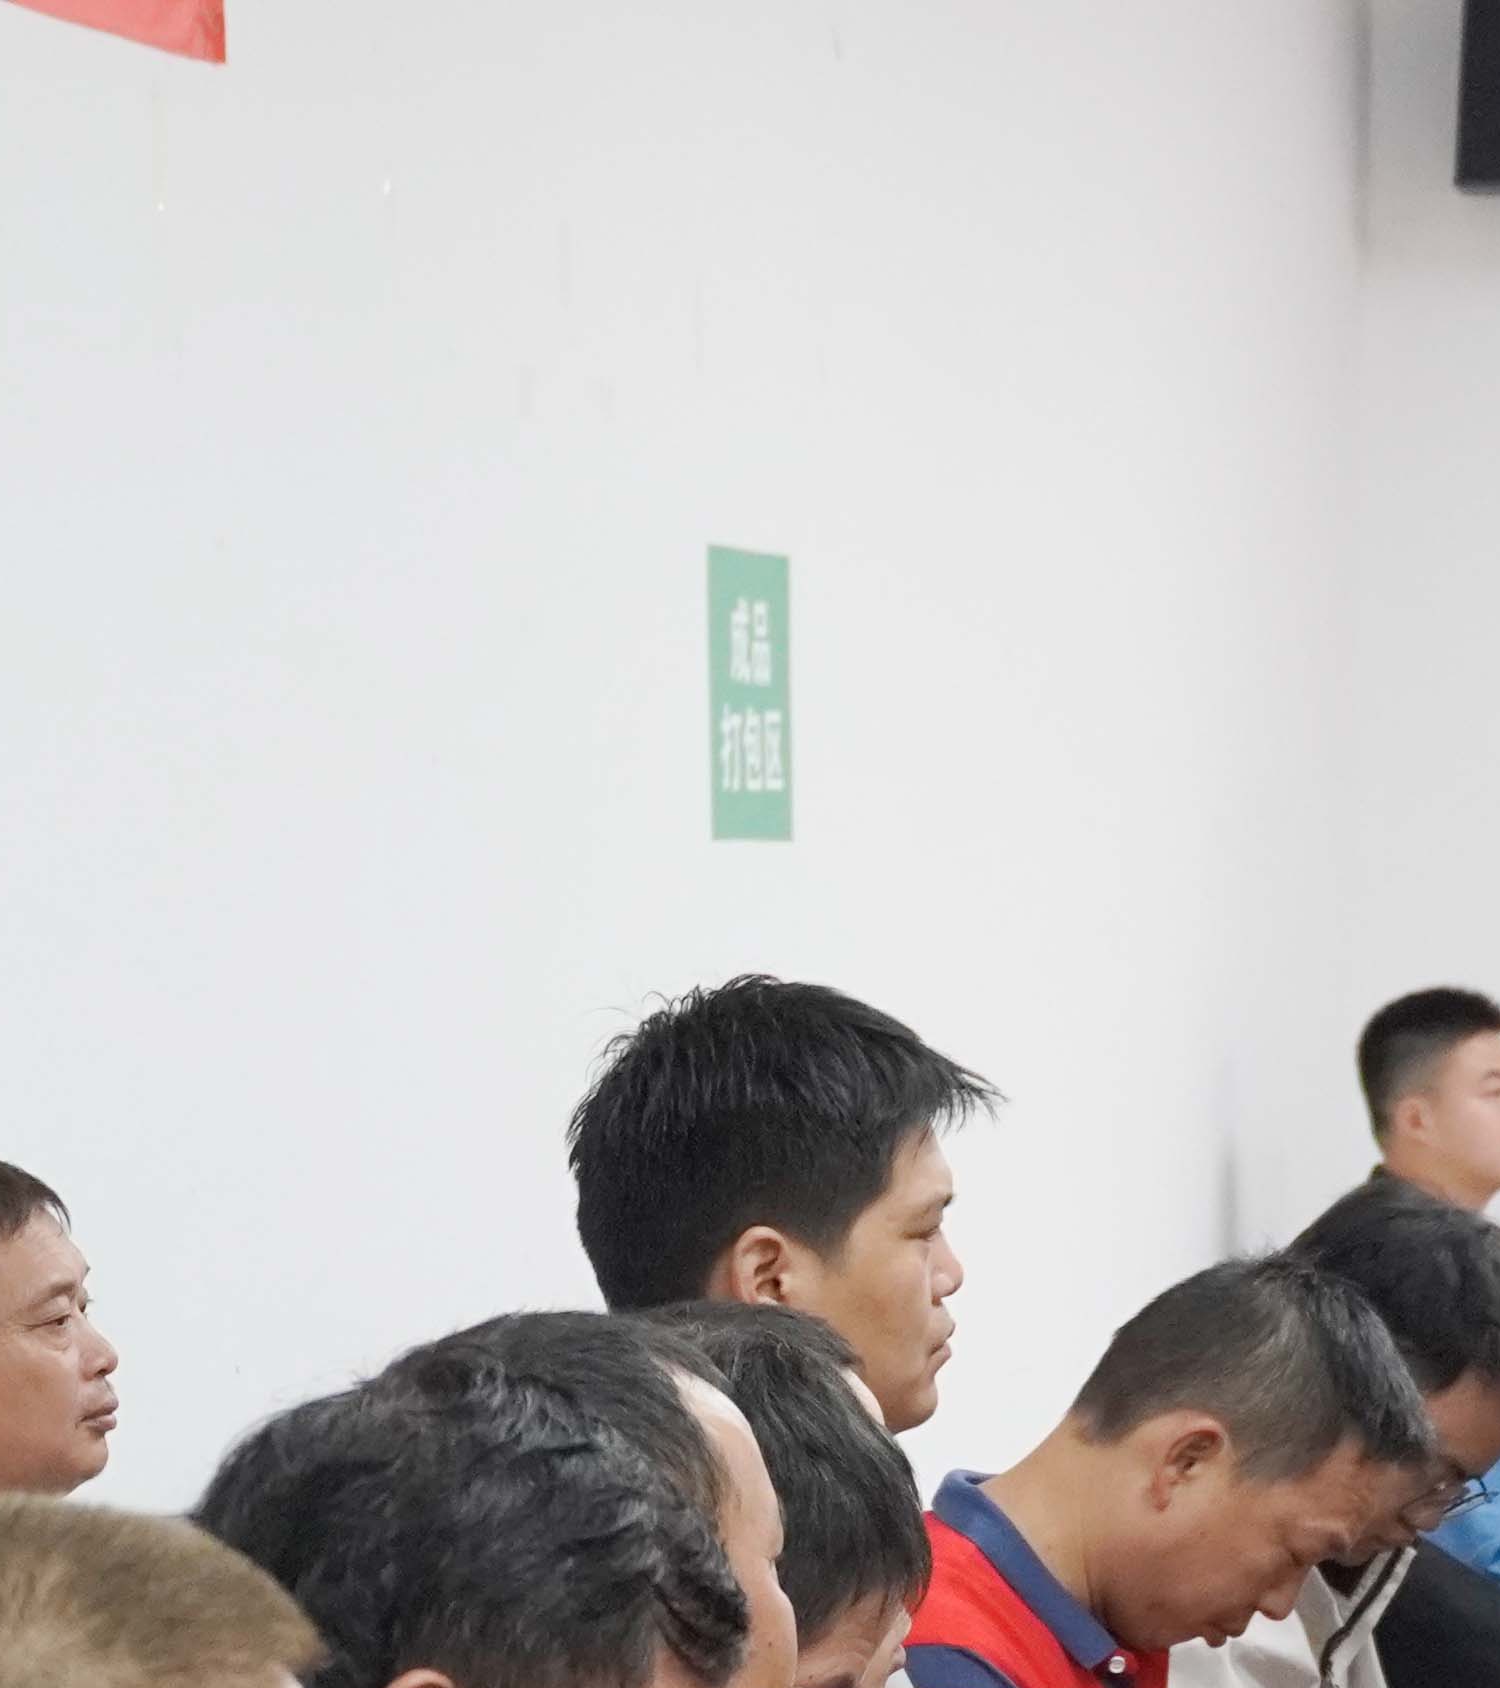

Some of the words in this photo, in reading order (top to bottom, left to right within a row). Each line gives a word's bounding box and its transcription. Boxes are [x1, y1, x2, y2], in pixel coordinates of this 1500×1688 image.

[730, 596, 772, 687] 成品
[721, 702, 785, 793] 打包区
